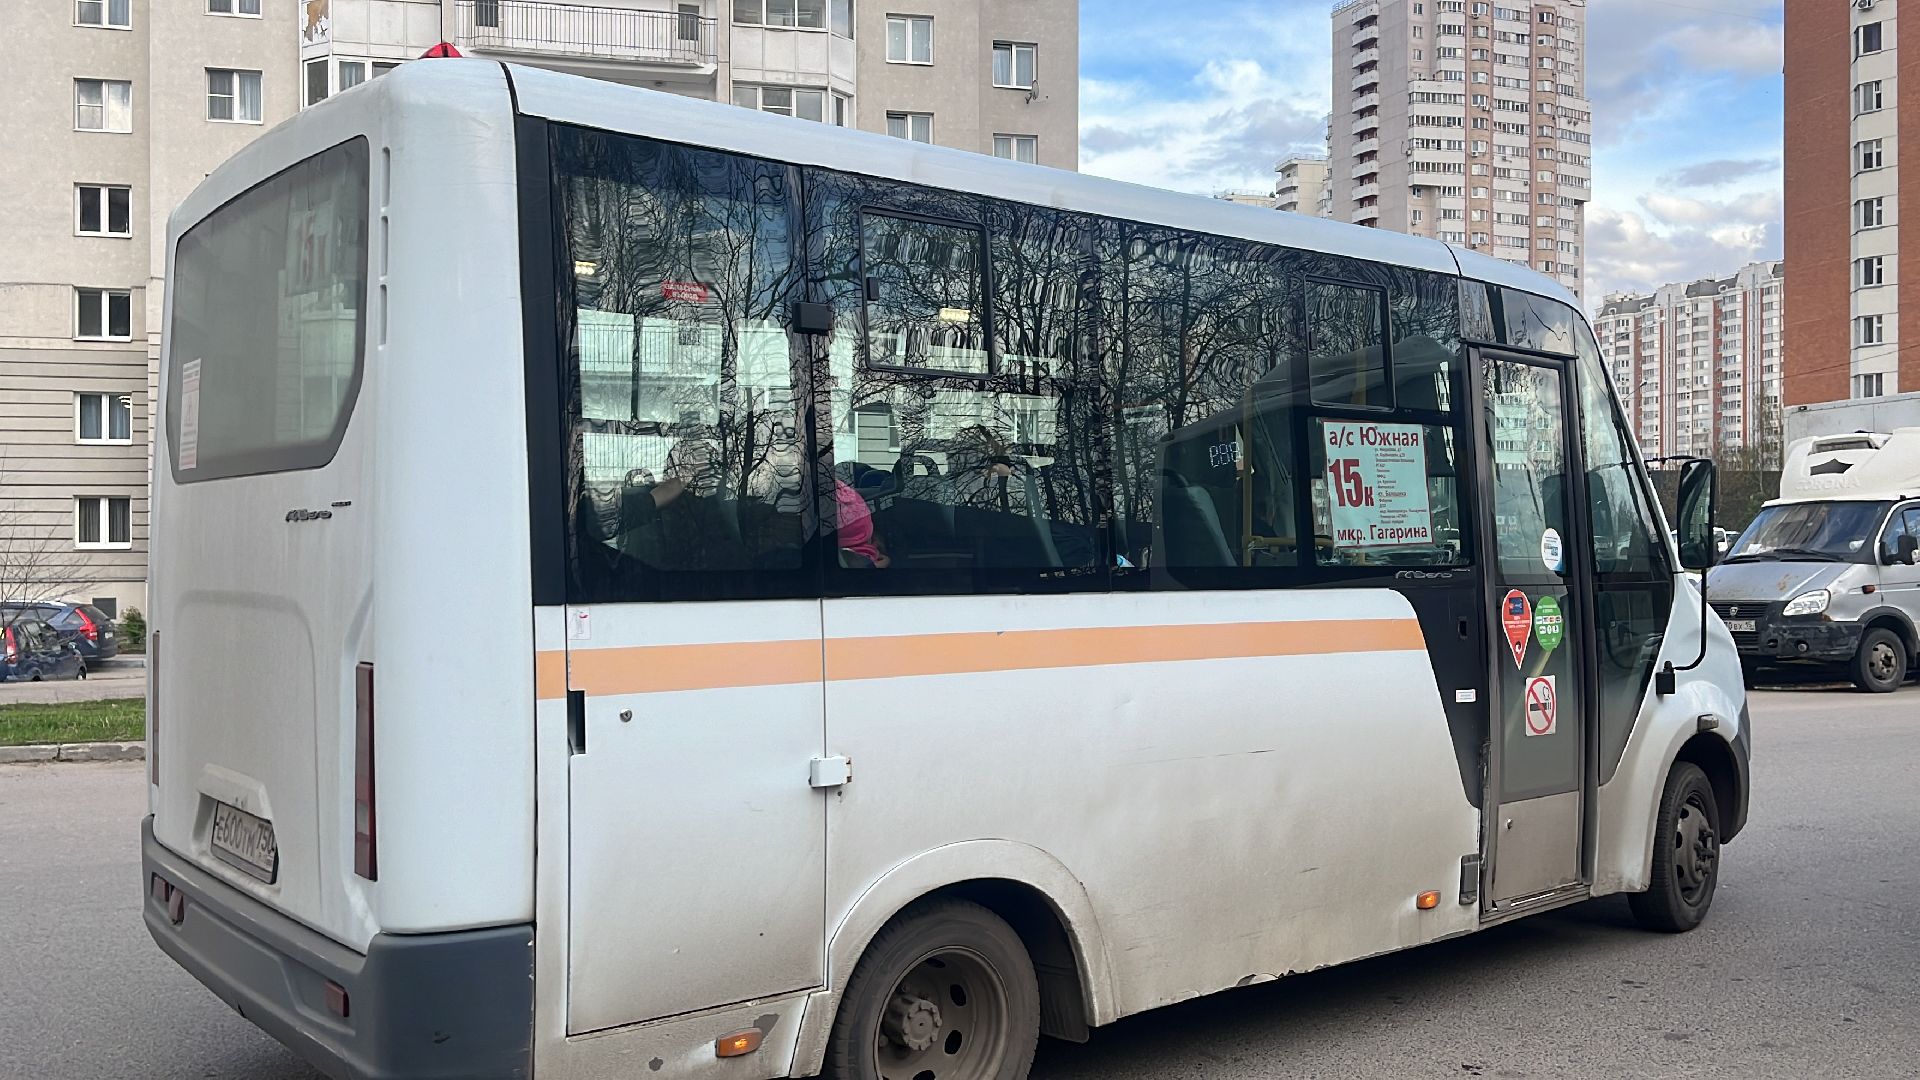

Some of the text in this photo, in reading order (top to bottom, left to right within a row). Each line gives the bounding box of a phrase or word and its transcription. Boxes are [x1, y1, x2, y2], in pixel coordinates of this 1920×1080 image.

[1329, 426, 1419, 448] а/с Южная
[1328, 459, 1375, 508] 15к
[1337, 524, 1428, 544] мкр. Гагарина
